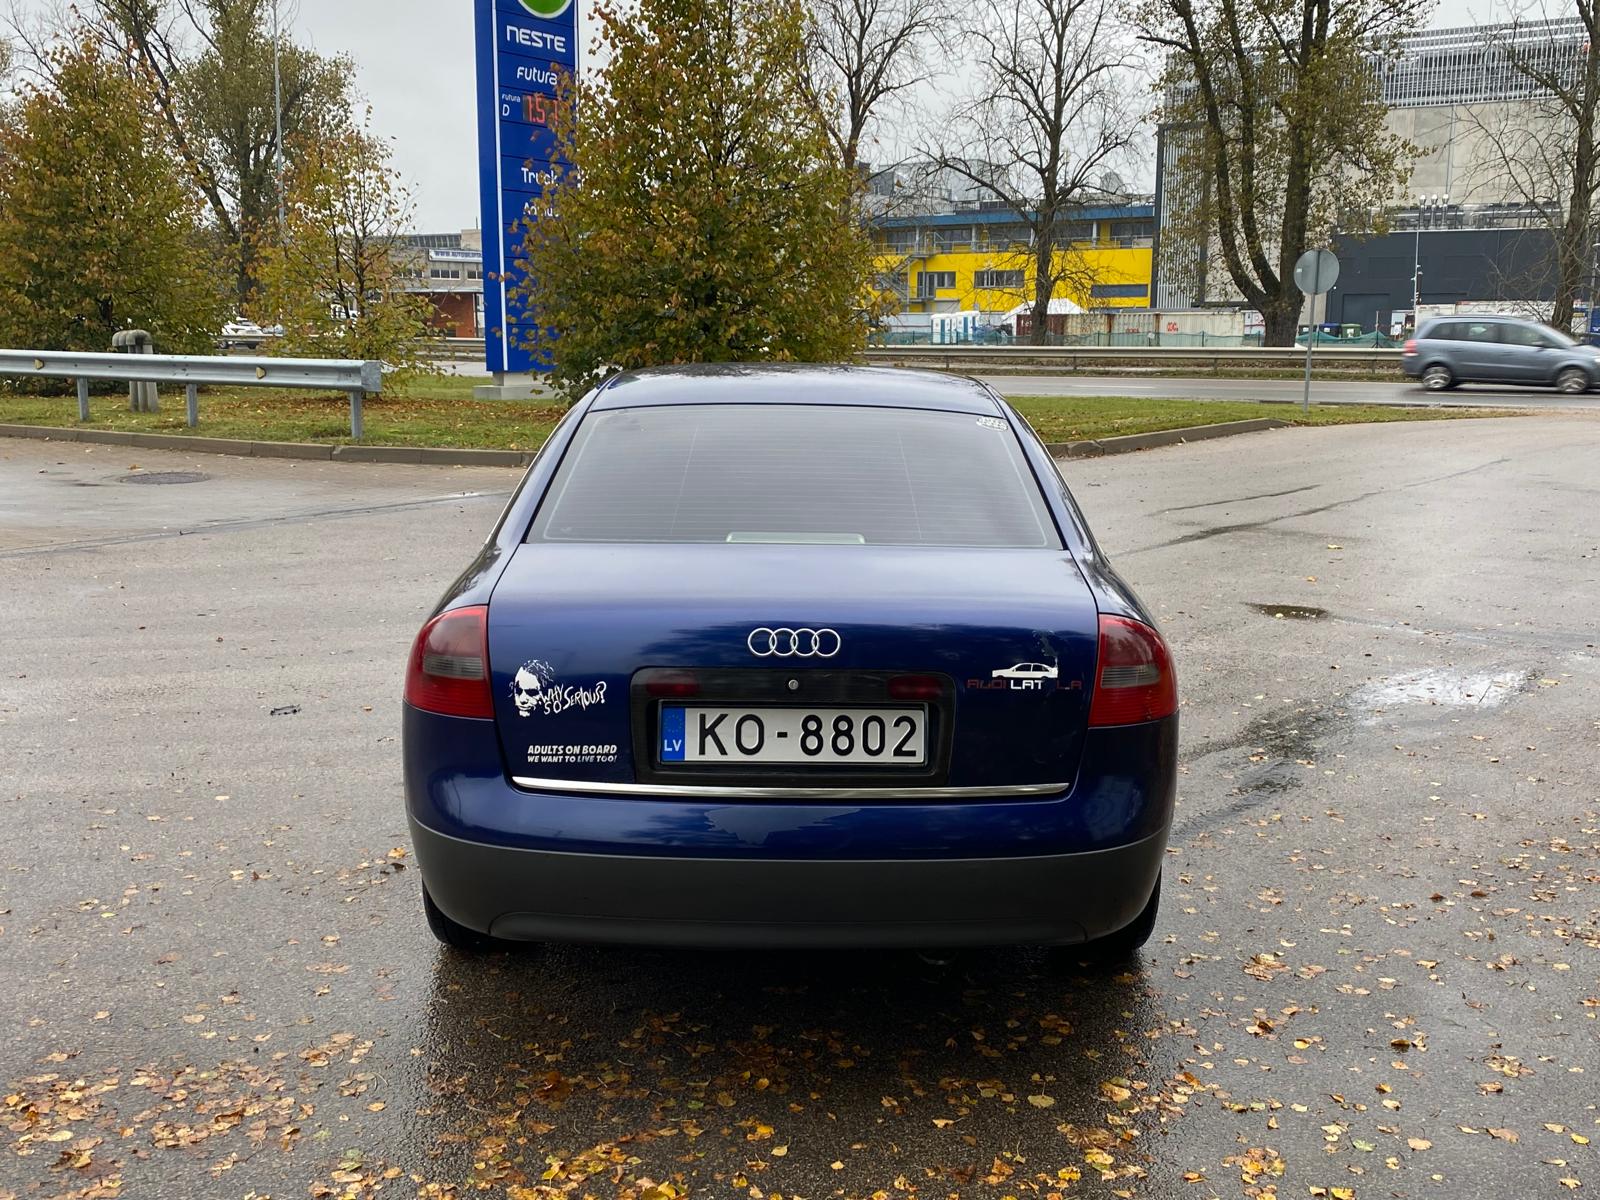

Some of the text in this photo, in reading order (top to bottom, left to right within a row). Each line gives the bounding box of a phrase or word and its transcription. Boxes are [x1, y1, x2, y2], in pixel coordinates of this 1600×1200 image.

[506, 25, 566, 53] NESTE
[516, 66, 558, 86] Futura
[502, 104, 510, 117] D
[965, 679, 1007, 690] AUDI
[540, 683, 564, 704] WHY
[562, 680, 607, 711] SERIOUS?
[543, 700, 562, 715] SO
[664, 713, 917, 757] LV KO-8802
[527, 744, 618, 755] ADULTS ON BOARD
[527, 754, 618, 763] WE WANT TO LIVE TOO!
